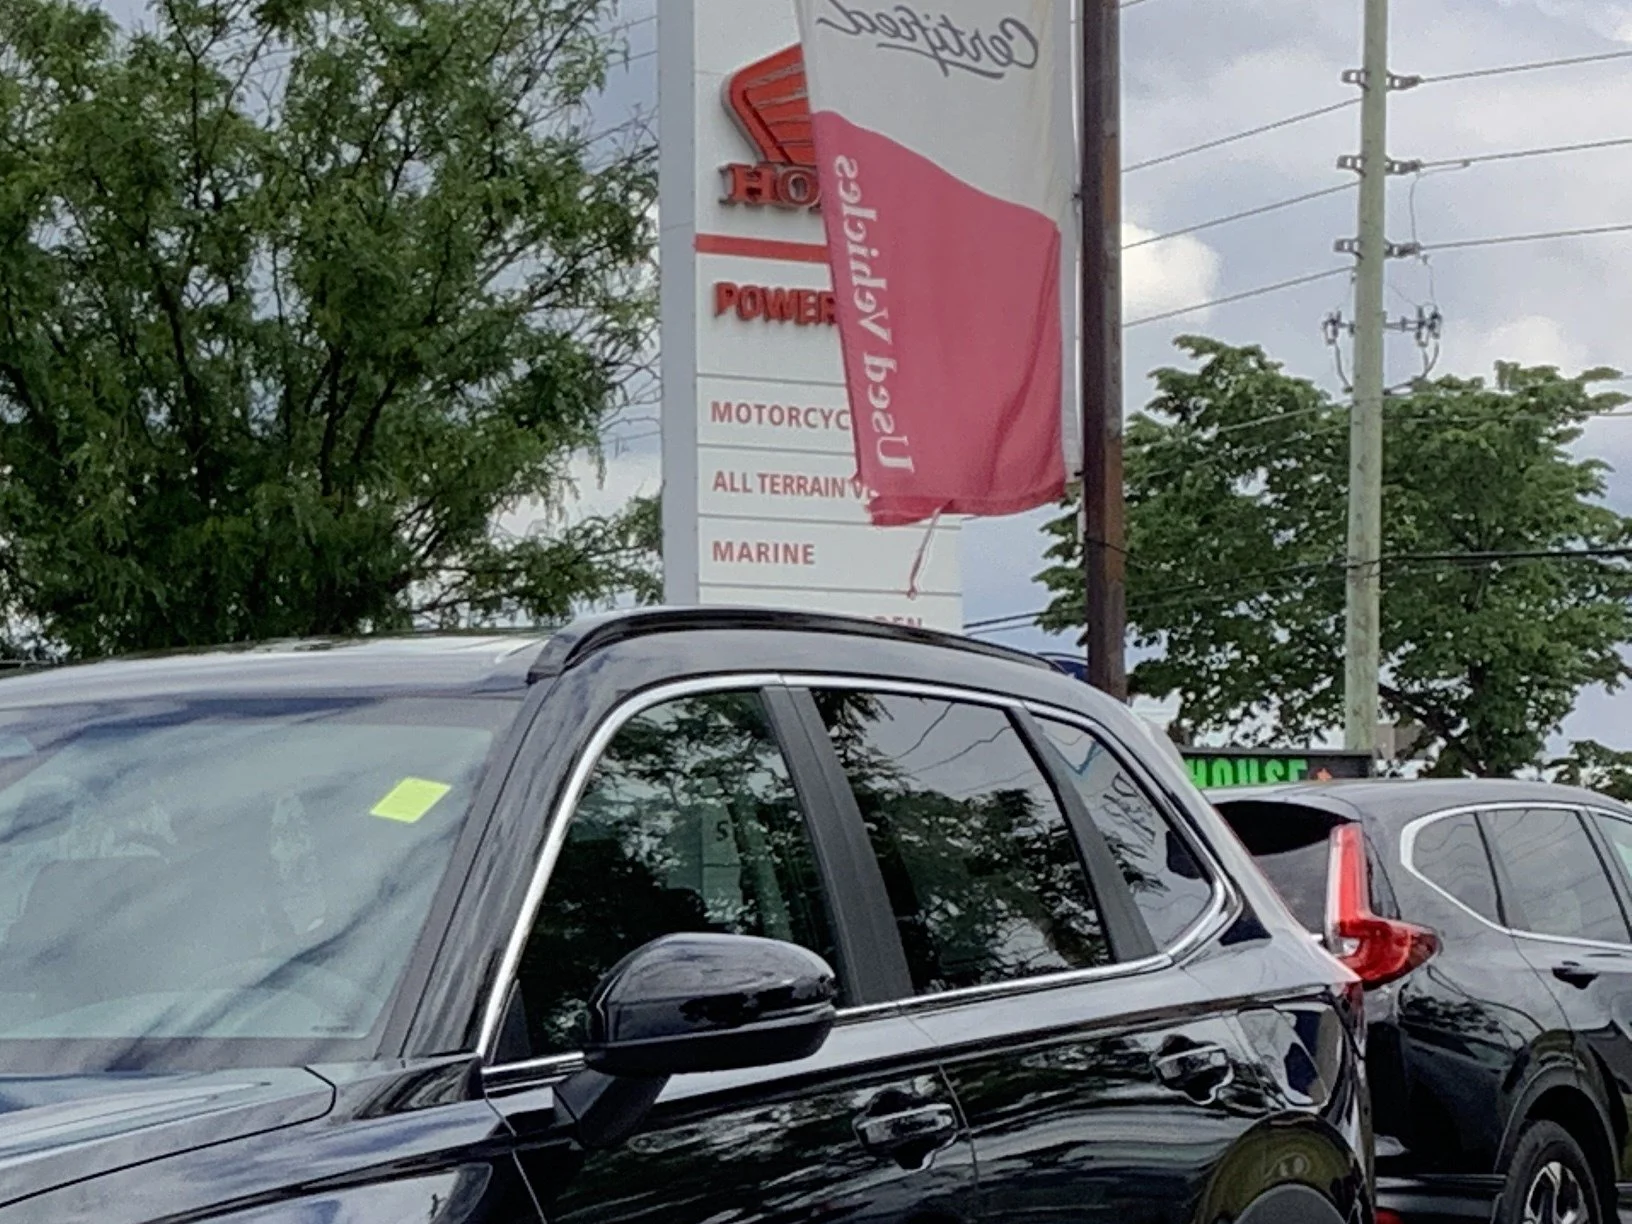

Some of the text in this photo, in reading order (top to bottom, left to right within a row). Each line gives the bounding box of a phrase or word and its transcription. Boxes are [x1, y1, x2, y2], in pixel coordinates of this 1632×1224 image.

[711, 401, 850, 431] MOTORCYC
[713, 471, 753, 494] ALL
[757, 473, 846, 499] TERRAIN
[712, 541, 816, 565] MARINE
